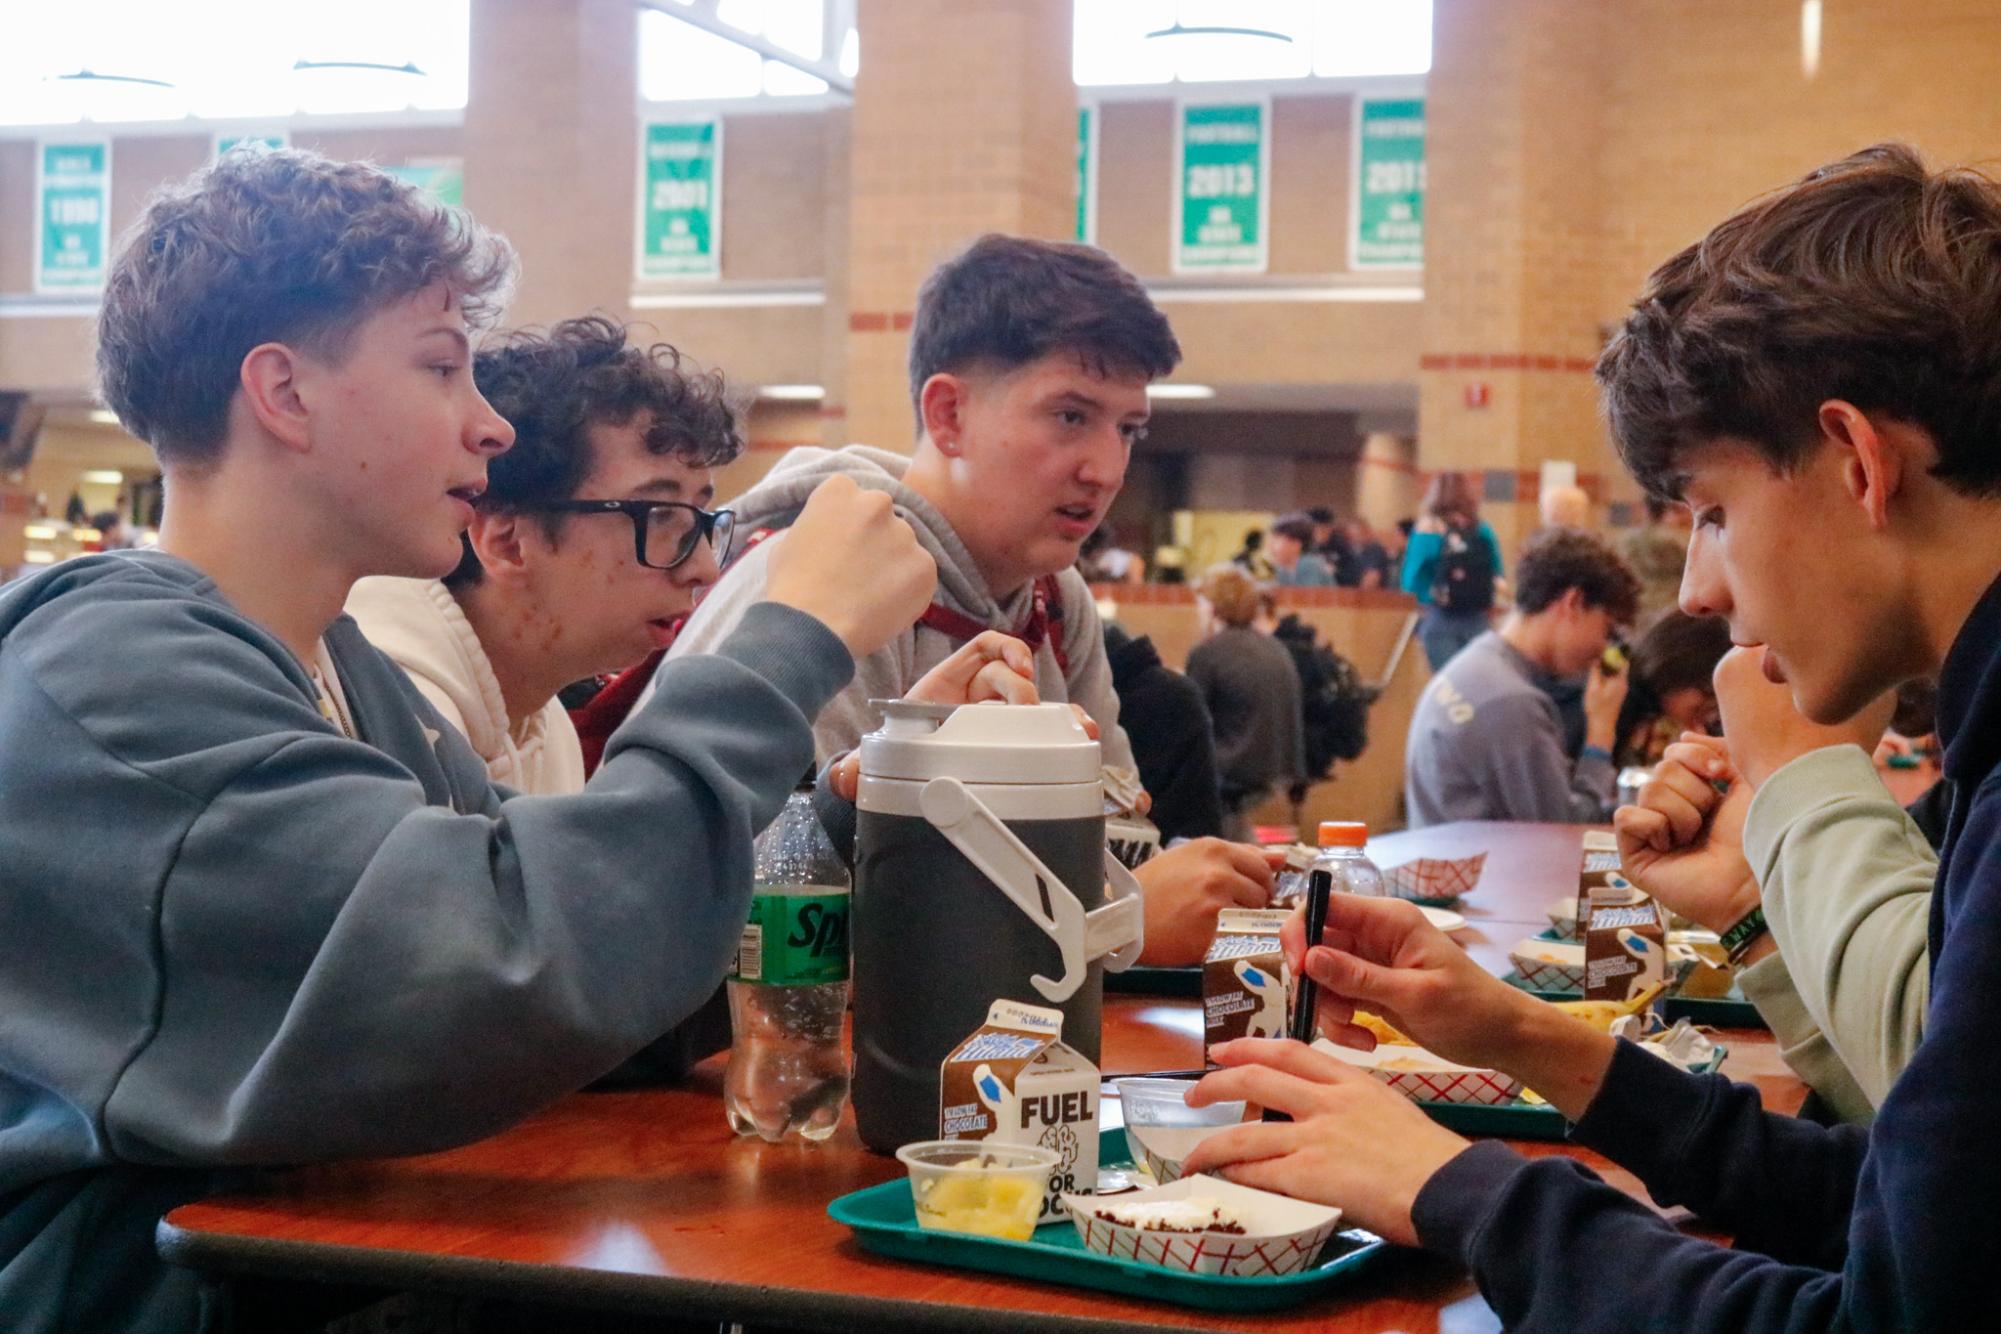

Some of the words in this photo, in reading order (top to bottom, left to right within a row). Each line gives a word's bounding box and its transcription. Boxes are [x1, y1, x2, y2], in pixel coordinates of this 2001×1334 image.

[1021, 1091, 1093, 1128] FUEL
[944, 1114, 988, 1134] CHOCOLATE
[1048, 1173, 1075, 1193] OR
